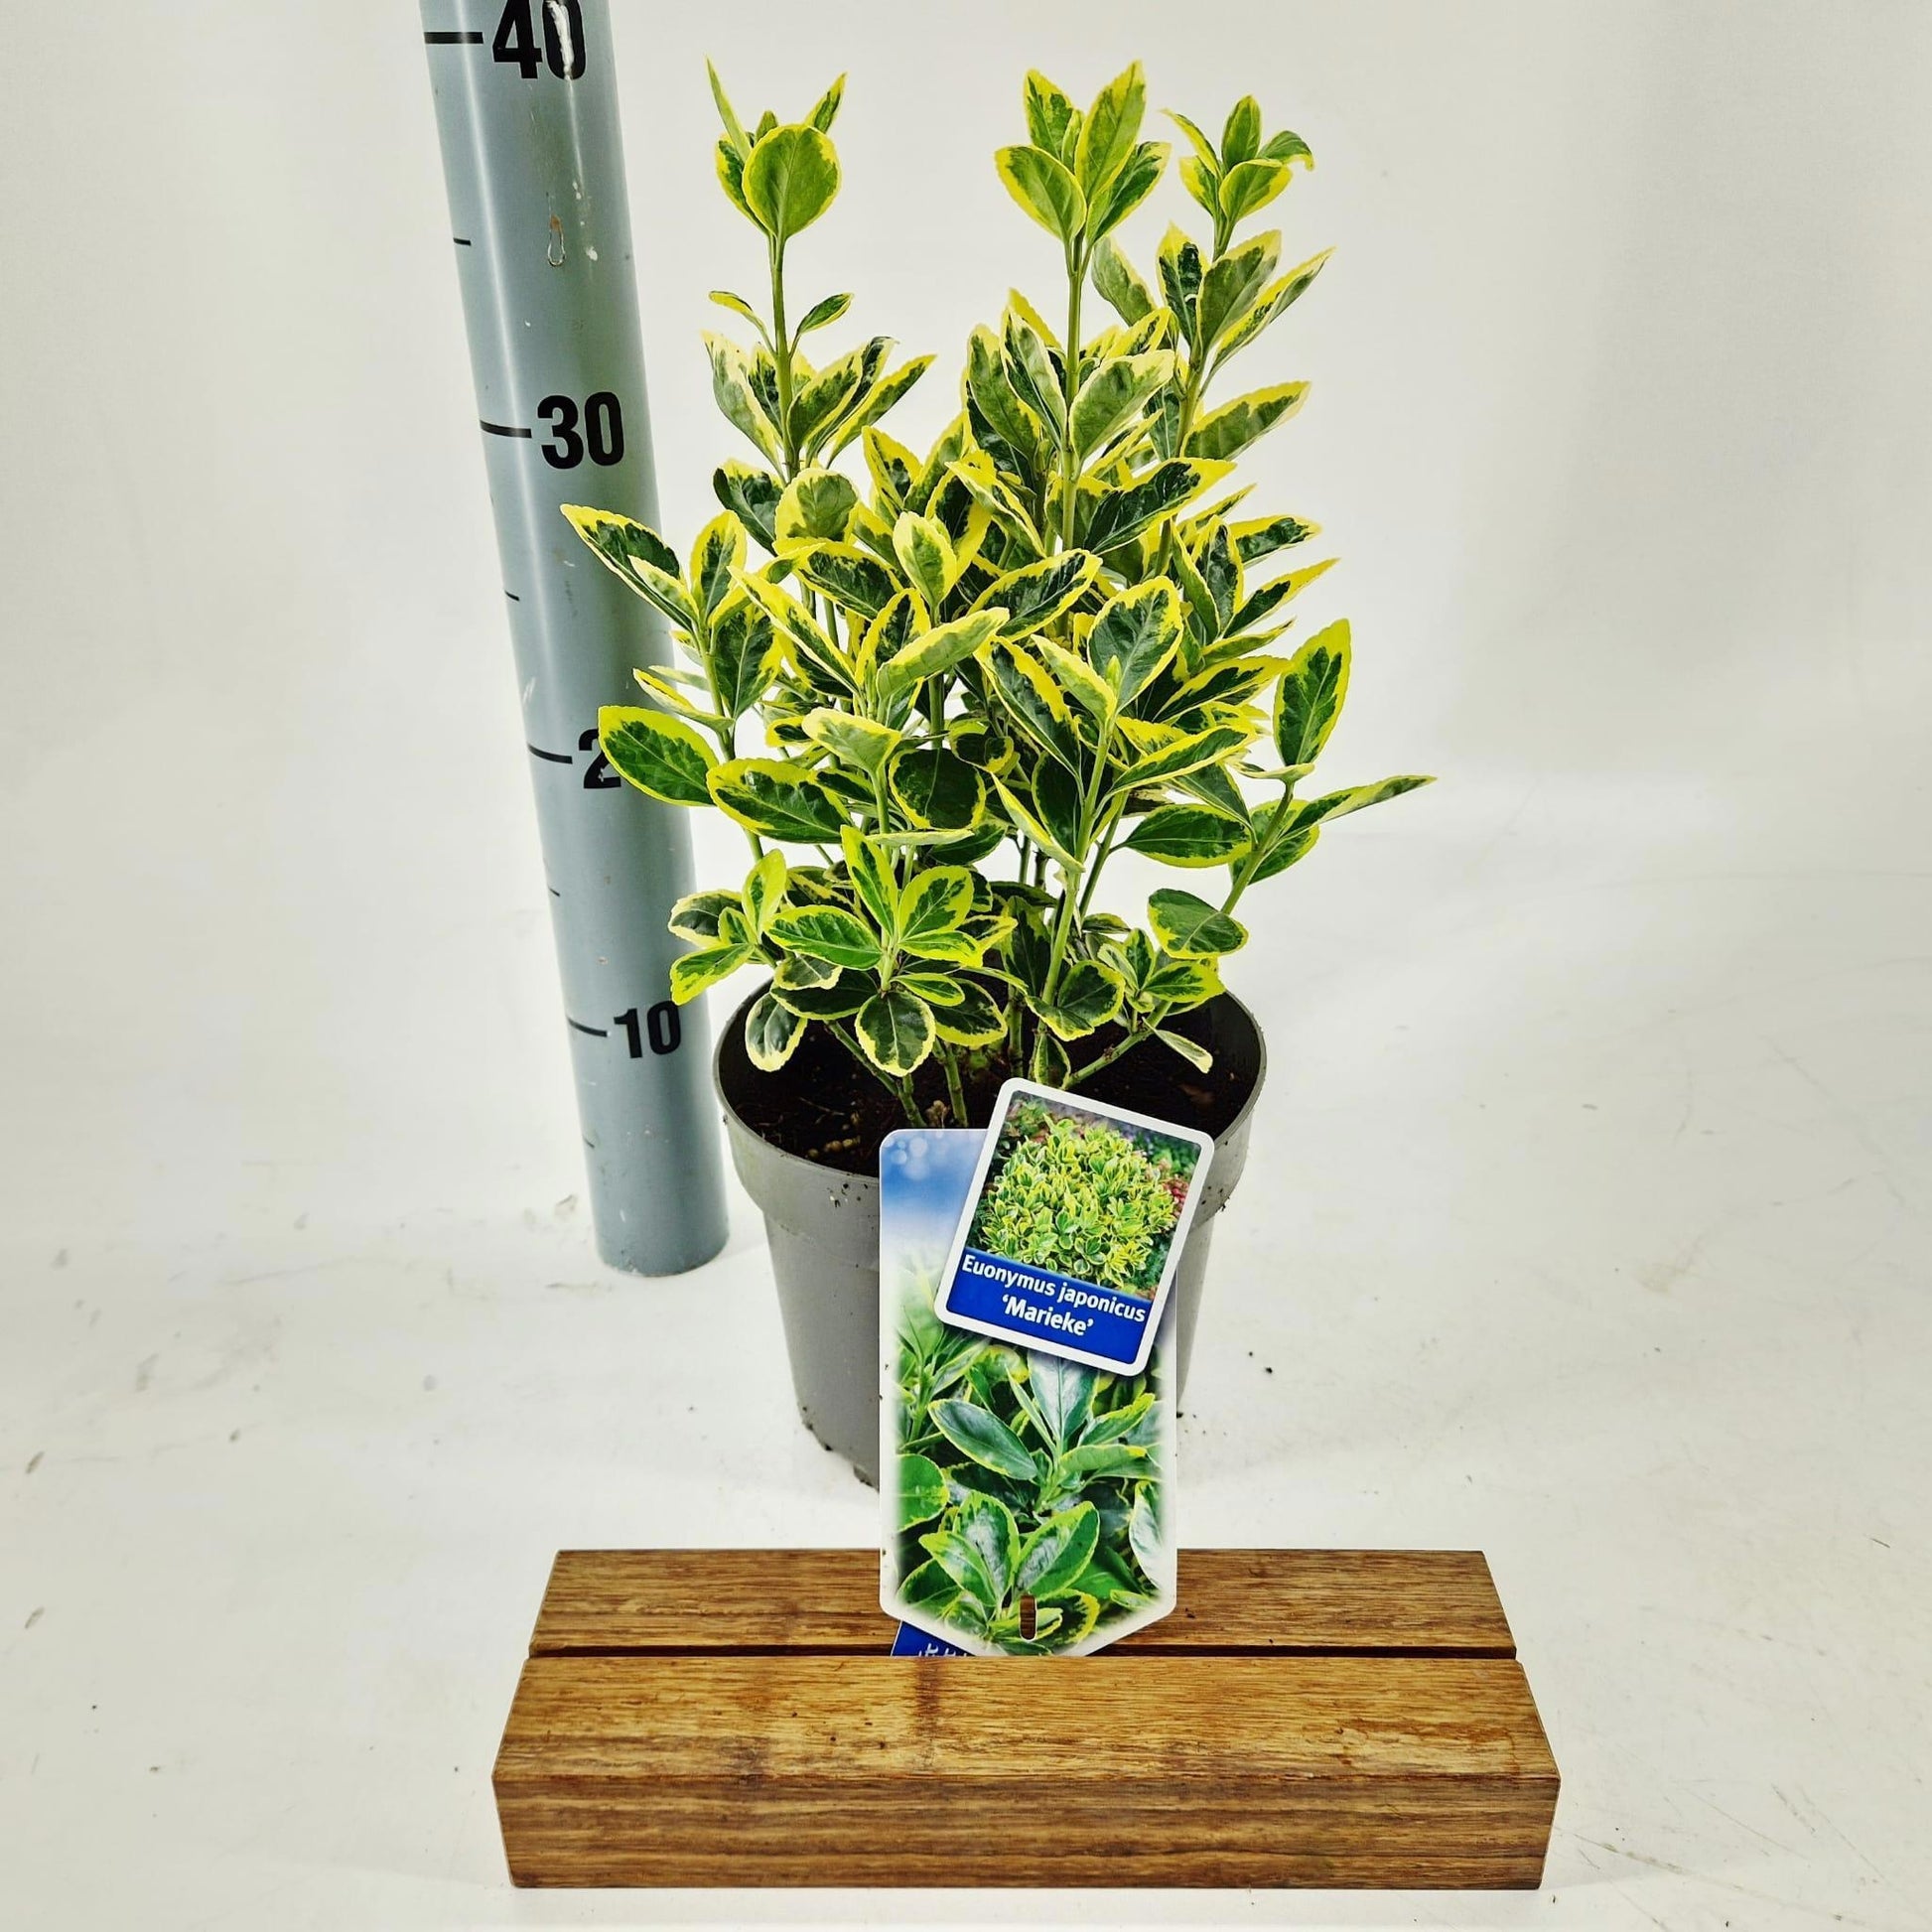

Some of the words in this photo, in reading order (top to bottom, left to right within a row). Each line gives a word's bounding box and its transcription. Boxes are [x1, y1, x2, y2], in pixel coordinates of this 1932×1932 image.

[492, 0, 587, 80] 40
[537, 391, 624, 470] 30
[578, 727, 622, 789] 2
[613, 1000, 681, 1059] 10
[961, 1253, 1056, 1297] Euonymus
[1056, 1282, 1147, 1322] japonicus
